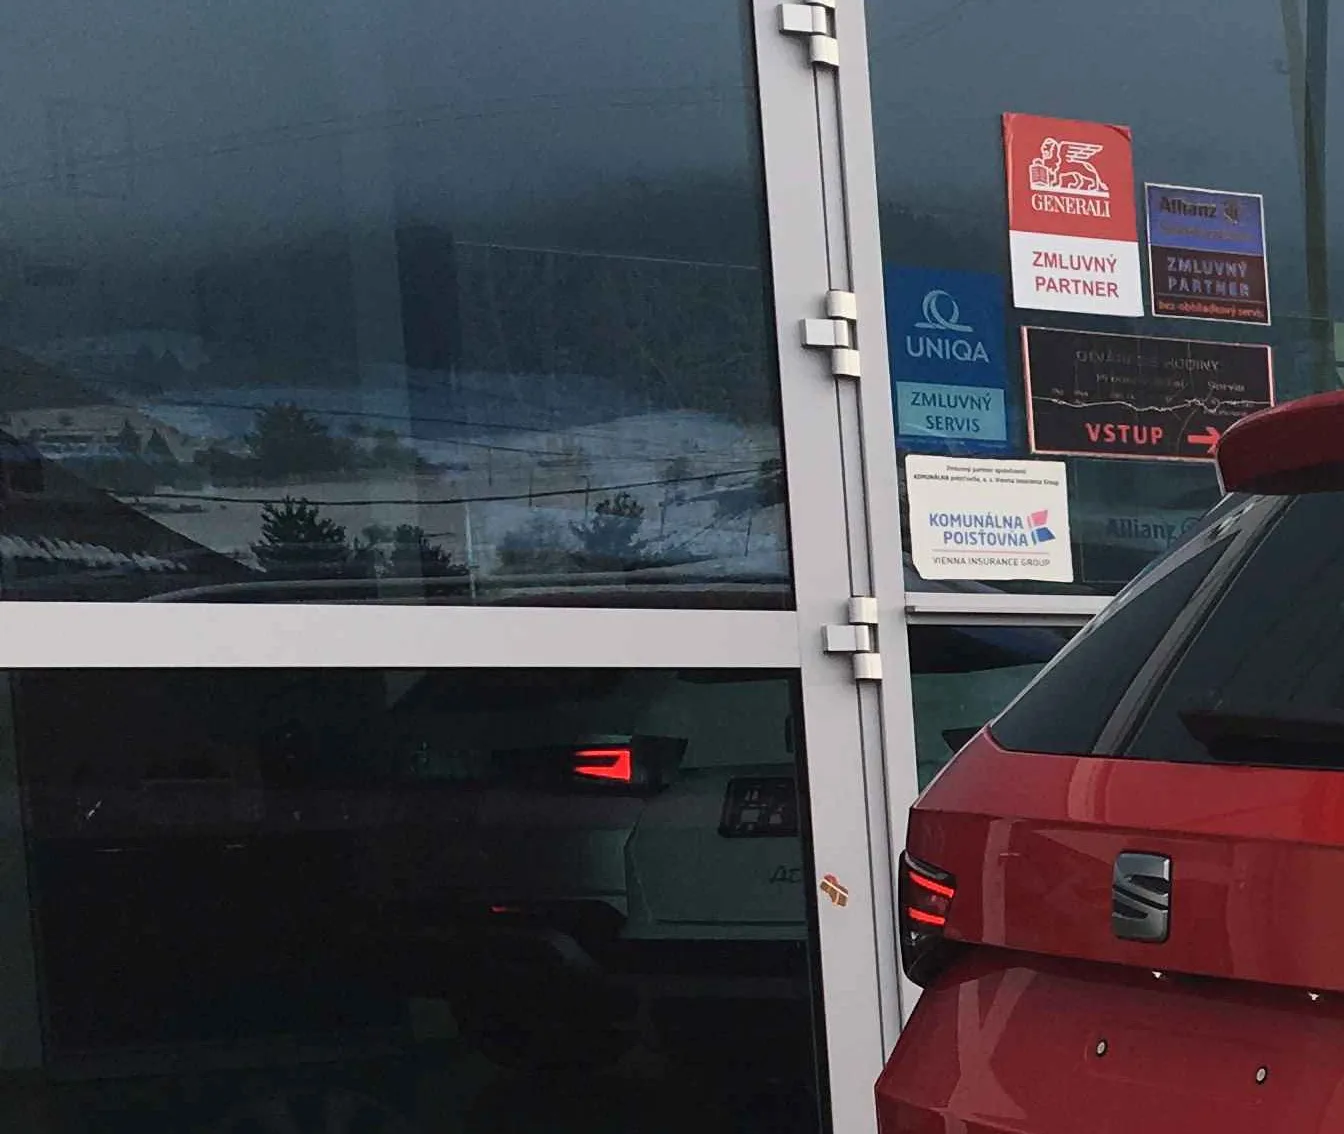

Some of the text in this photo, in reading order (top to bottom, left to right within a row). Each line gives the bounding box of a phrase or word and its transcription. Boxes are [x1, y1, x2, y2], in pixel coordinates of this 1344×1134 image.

[1031, 192, 1111, 218] GENERALI
[1161, 196, 1217, 219] Allianz
[1032, 250, 1118, 274] ZMLUVNÝ
[1166, 255, 1248, 278] ZMLUVNÝ
[1034, 276, 1119, 298] PARTNER
[1168, 275, 1250, 297] PARTNER
[906, 335, 989, 363] UNIQA
[911, 391, 992, 412] ZMLUVNÝ
[926, 415, 981, 433] SERVIS
[1086, 422, 1164, 445] VSTUP
[929, 511, 1024, 529] KOMUNÁLNA
[1106, 517, 1178, 541] Allianz
[943, 528, 1029, 547] POISŤOVŇA
[933, 556, 1051, 567] VIENNA INSURANCE GROUP
